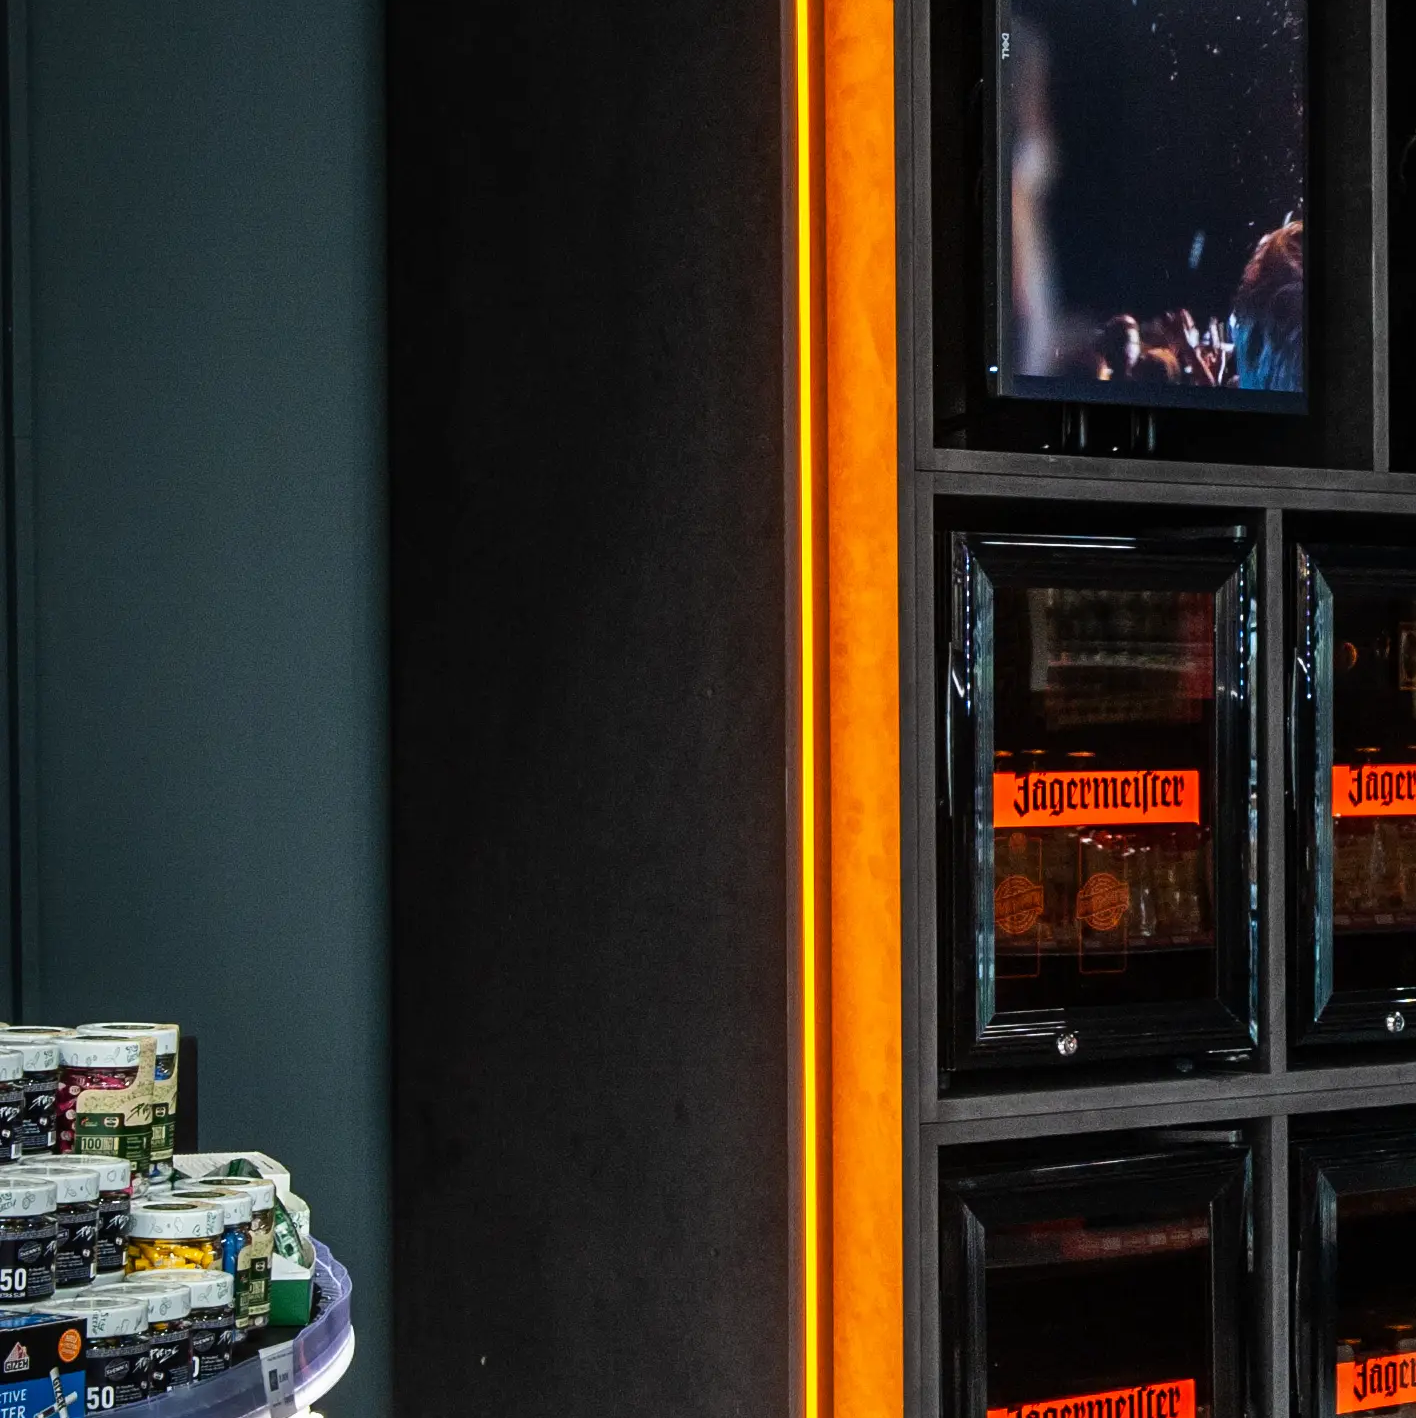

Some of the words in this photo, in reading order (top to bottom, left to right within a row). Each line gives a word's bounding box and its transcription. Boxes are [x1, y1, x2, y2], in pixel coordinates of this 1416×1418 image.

[1001, 32, 1010, 60] DELL
[1013, 770, 1185, 818] Jägermeister
[0, 1268, 27, 1291] 50
[86, 1385, 115, 1410] 50
